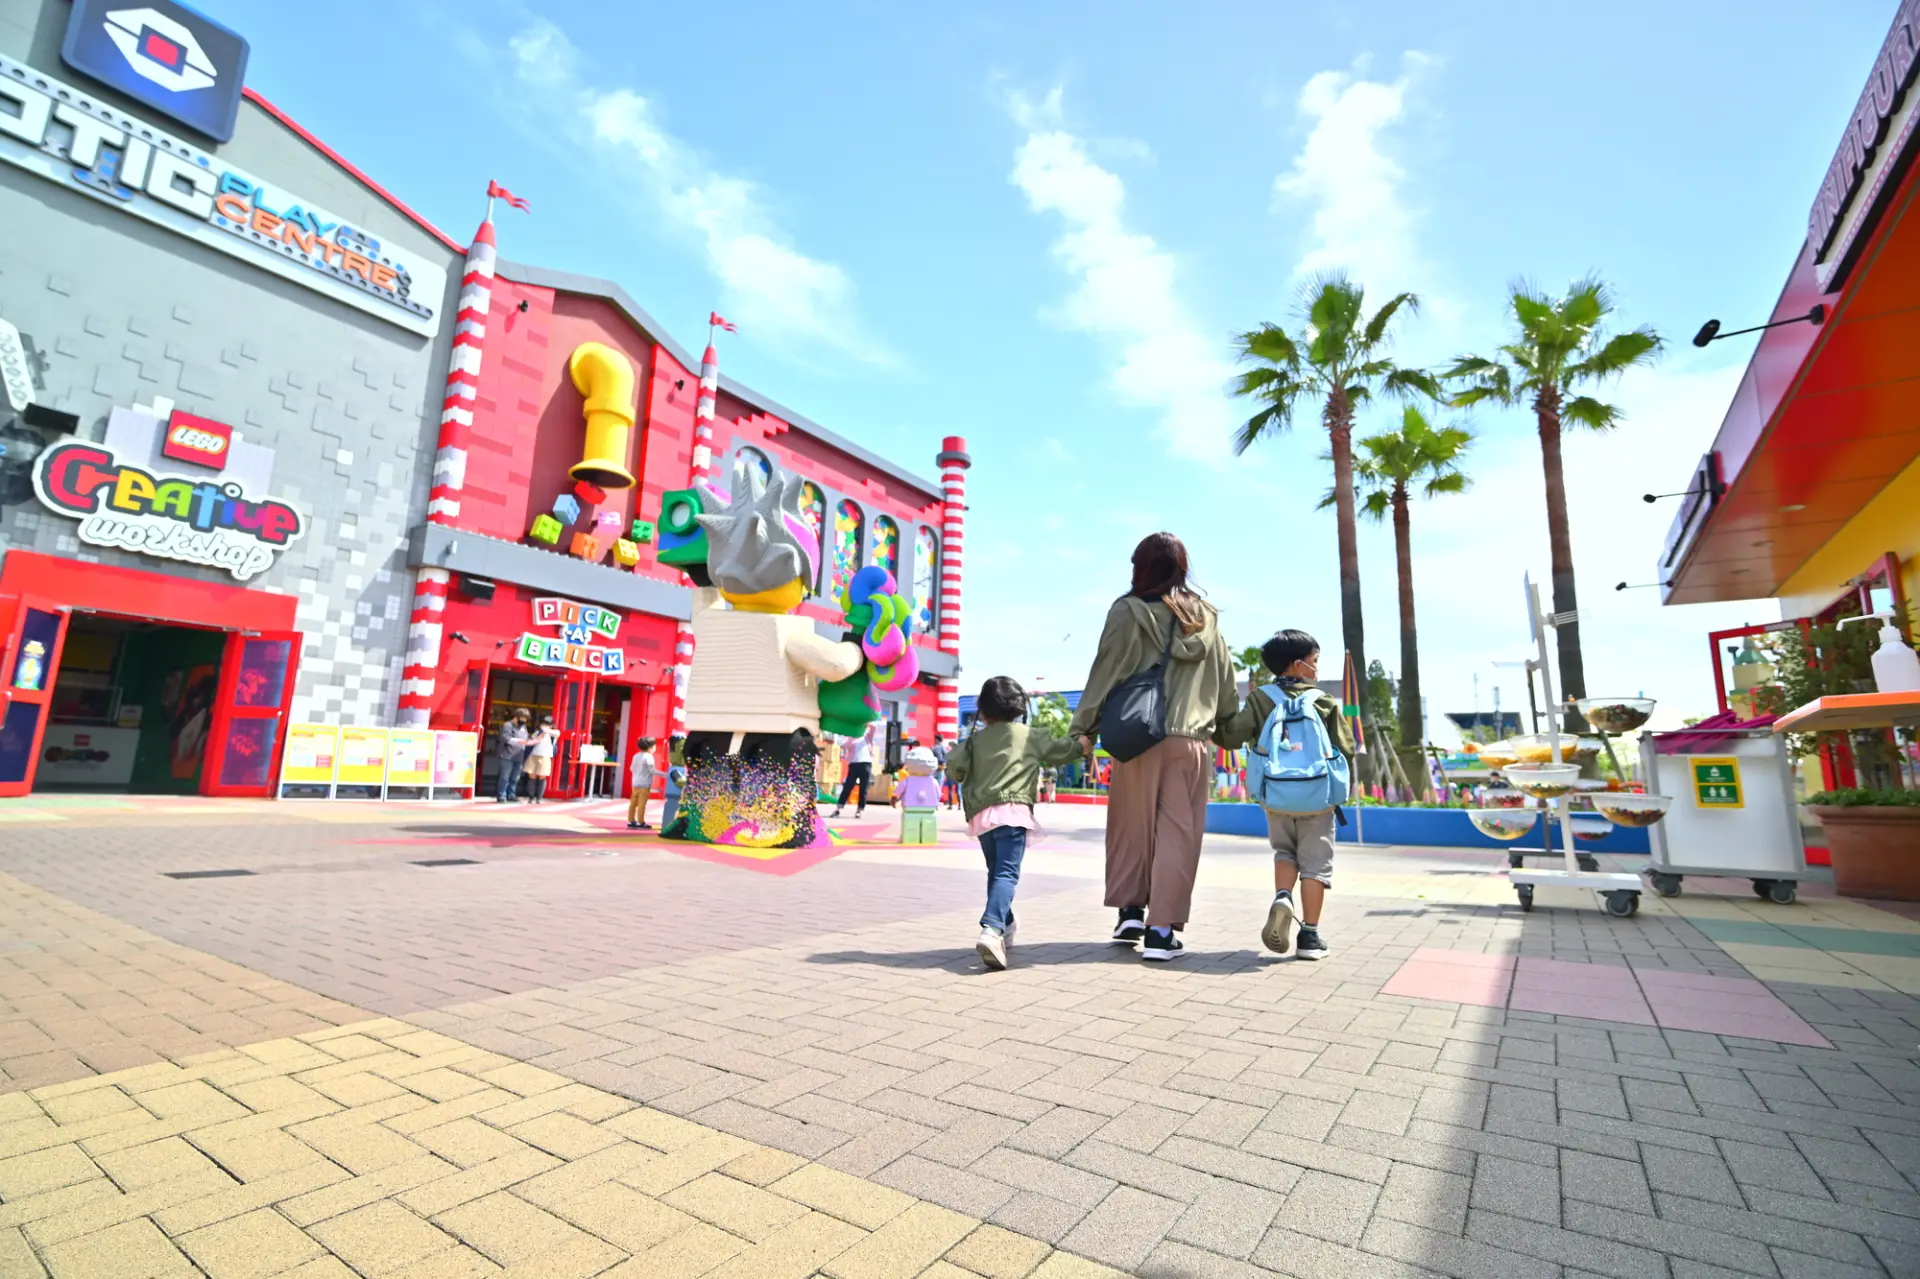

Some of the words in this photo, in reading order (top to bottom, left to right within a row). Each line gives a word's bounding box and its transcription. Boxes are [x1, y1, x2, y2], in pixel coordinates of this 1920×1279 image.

[220, 171, 337, 238] PLAY
[215, 193, 397, 293] CENTRE
[172, 425, 226, 453] LEGO
[85, 516, 276, 576] workshop
[542, 603, 614, 632] PICK
[526, 640, 620, 670] BRICK
